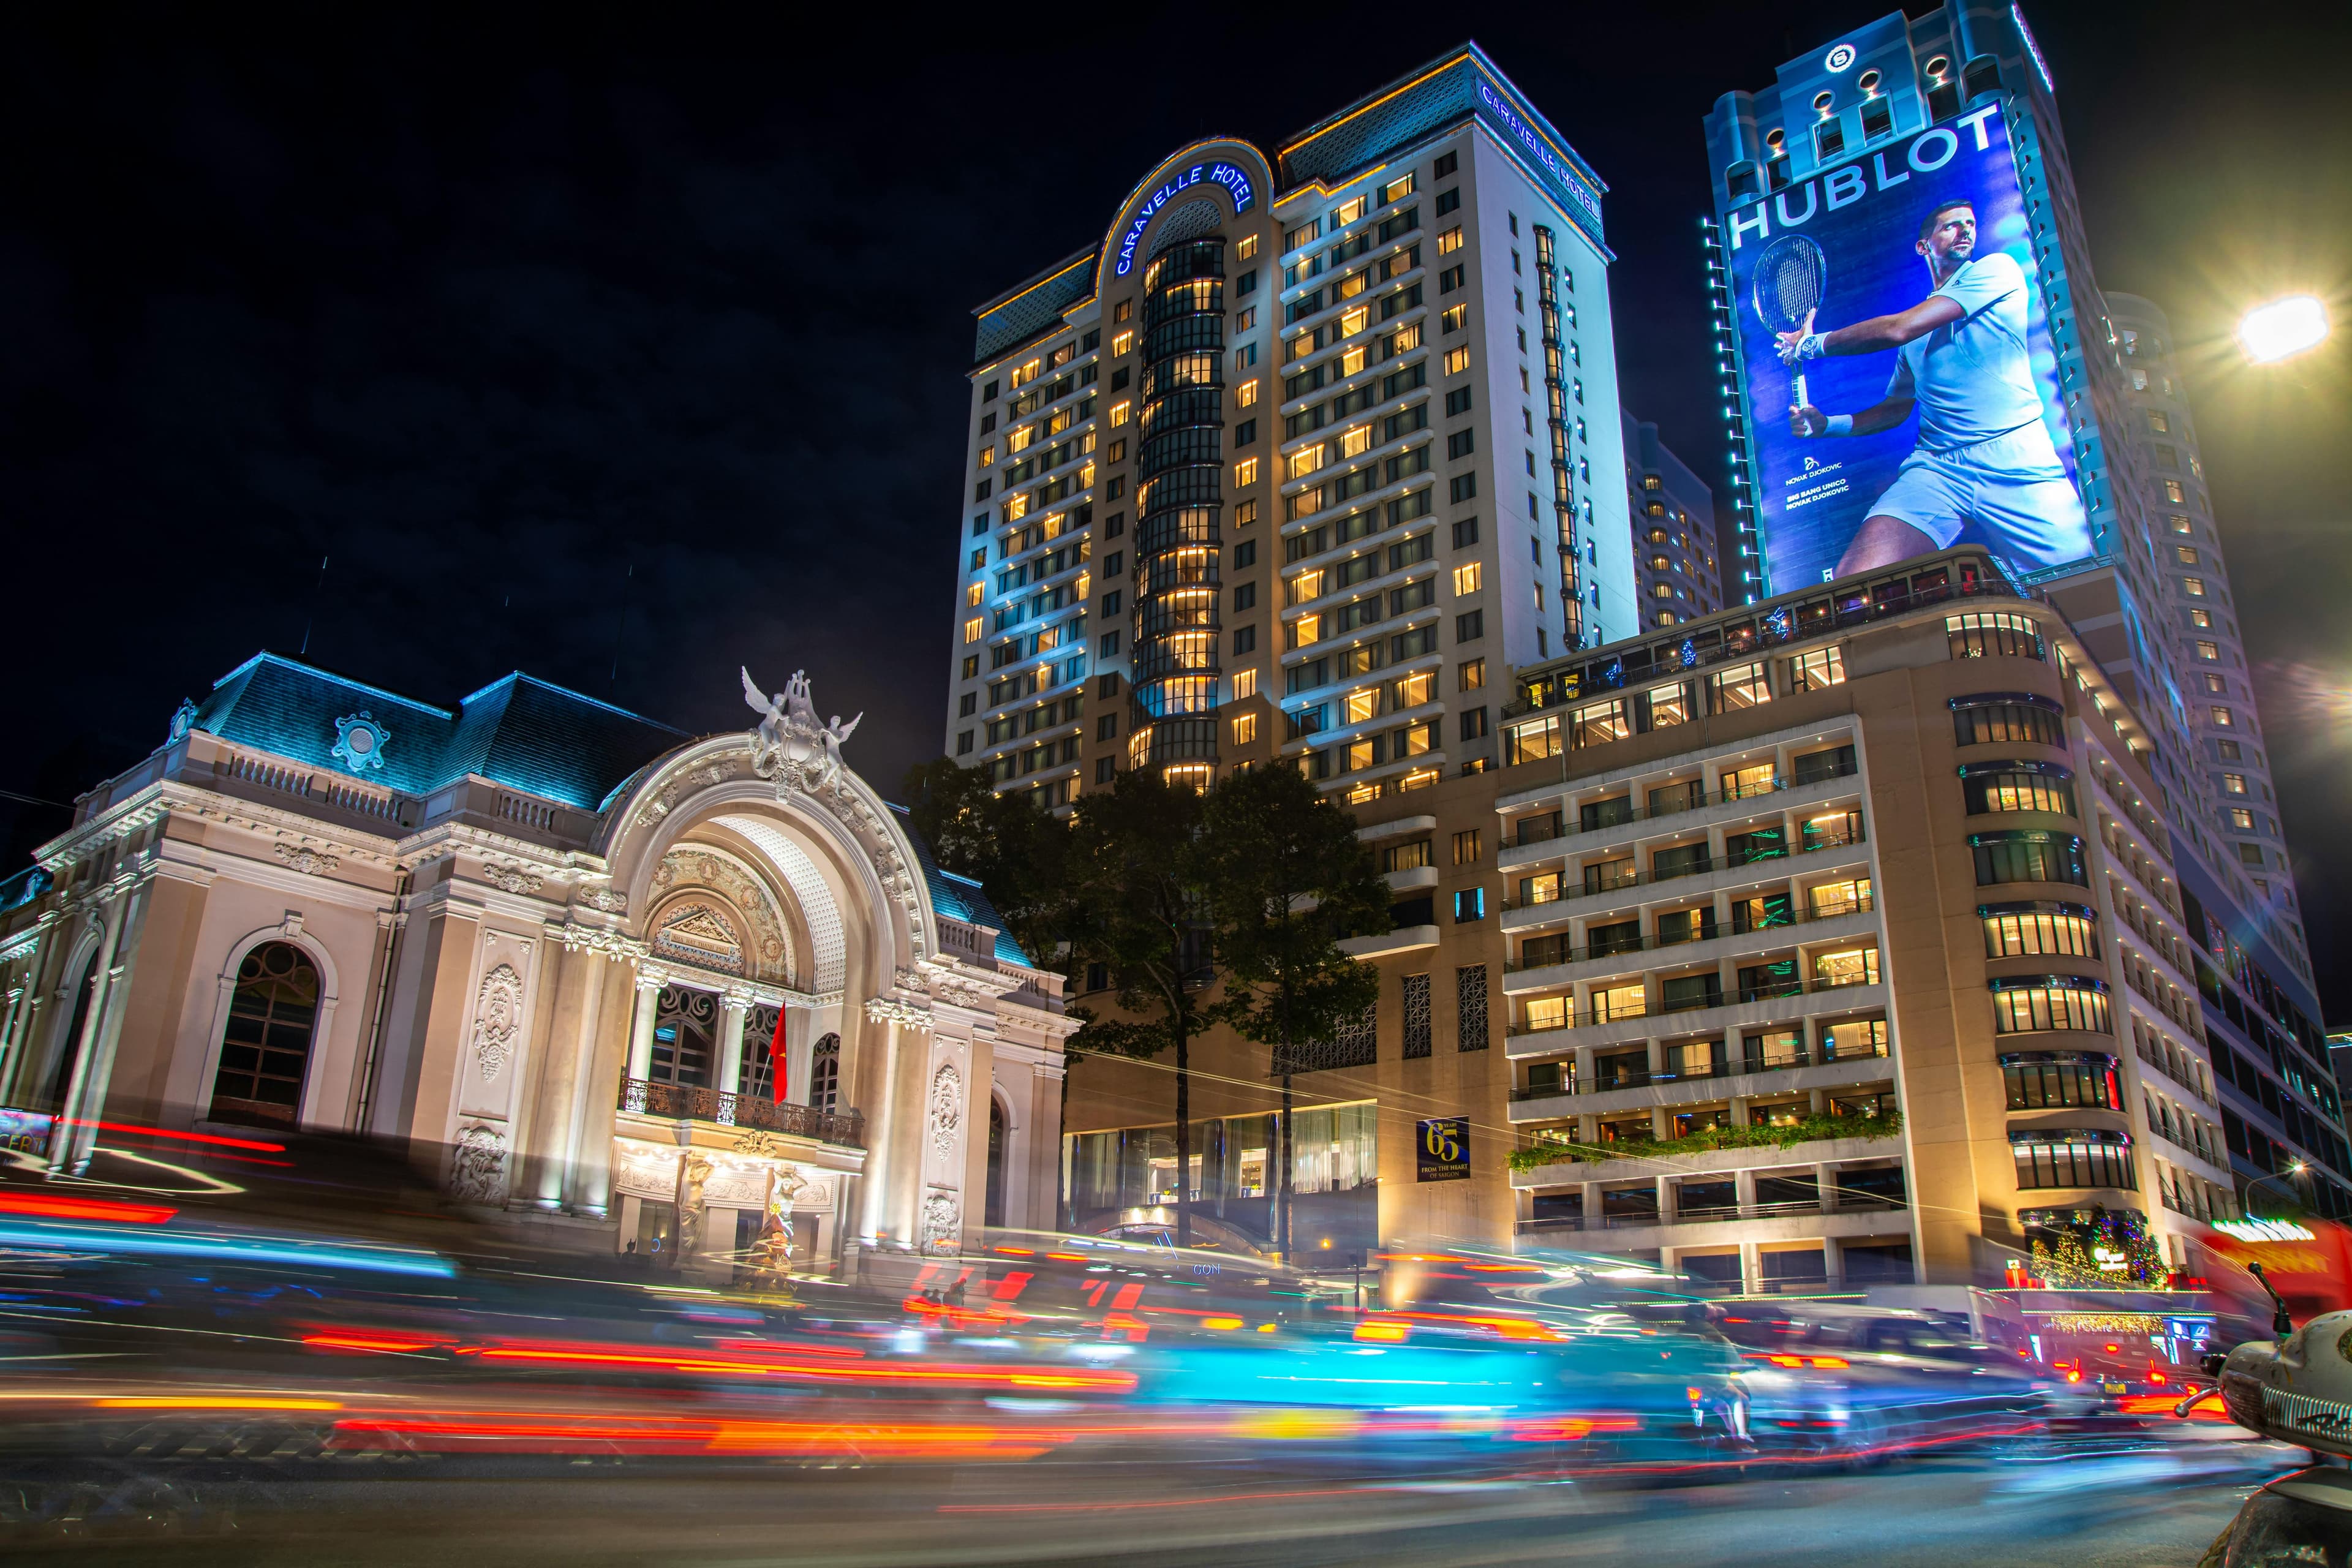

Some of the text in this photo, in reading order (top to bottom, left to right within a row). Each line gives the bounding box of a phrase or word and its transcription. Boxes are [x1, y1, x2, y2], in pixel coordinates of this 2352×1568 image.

[1480, 85, 1600, 219] CARAVELLE HOTEL
[1728, 104, 1999, 251] HUBLOT
[1117, 163, 1253, 275] CARAVELLE HOTEL
[1785, 462, 1842, 486] NOVAK DJOKOVIC
[1787, 478, 1846, 503] BIG BANG UNICO
[1785, 485, 1850, 510] NOVAK DJOKOVIC
[1427, 1122, 1460, 1161] 65
